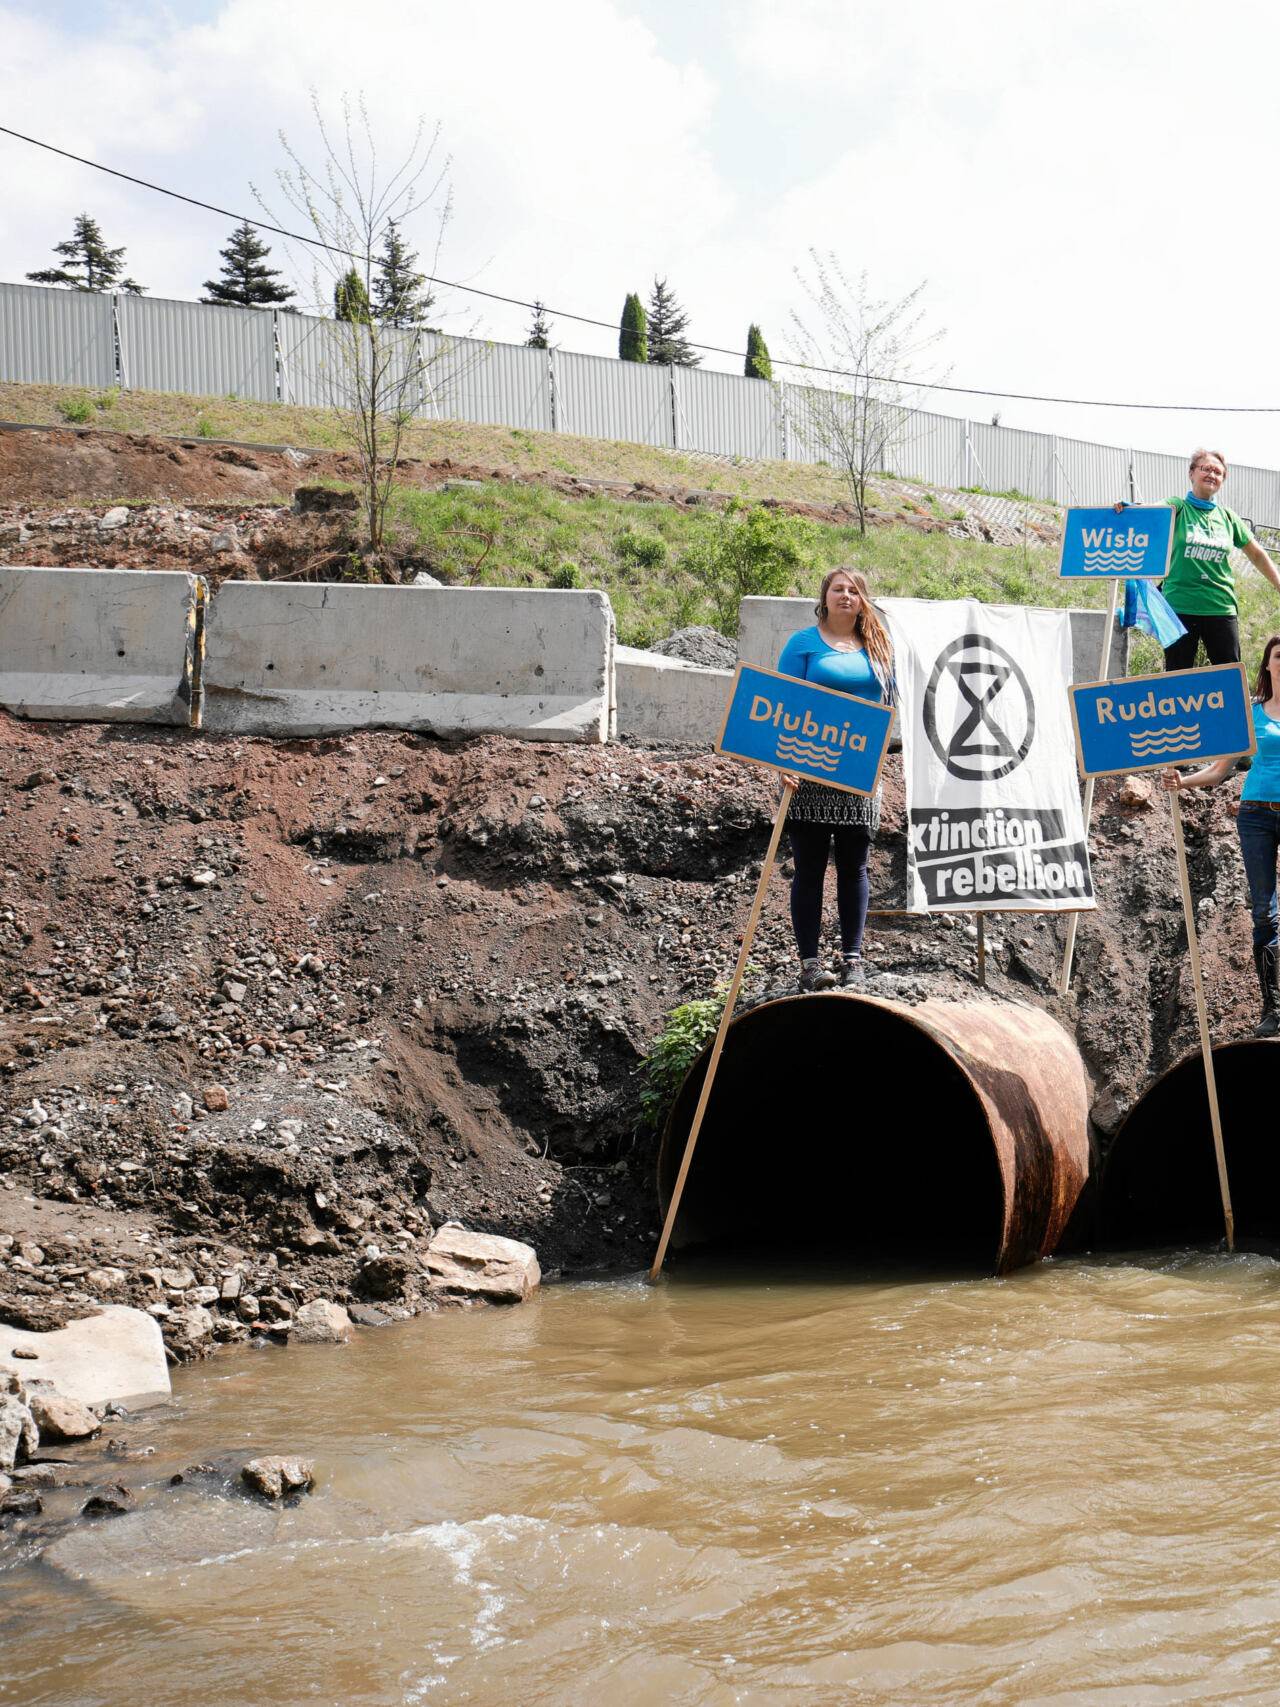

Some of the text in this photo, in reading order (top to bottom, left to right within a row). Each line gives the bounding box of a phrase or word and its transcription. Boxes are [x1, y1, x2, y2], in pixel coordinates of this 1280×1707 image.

[1082, 527, 1149, 548] Wisła
[748, 695, 866, 752] Dłubnia
[1095, 690, 1225, 725] Rudawa
[911, 810, 1041, 851] xtinction
[936, 847, 1084, 897] rebellion
